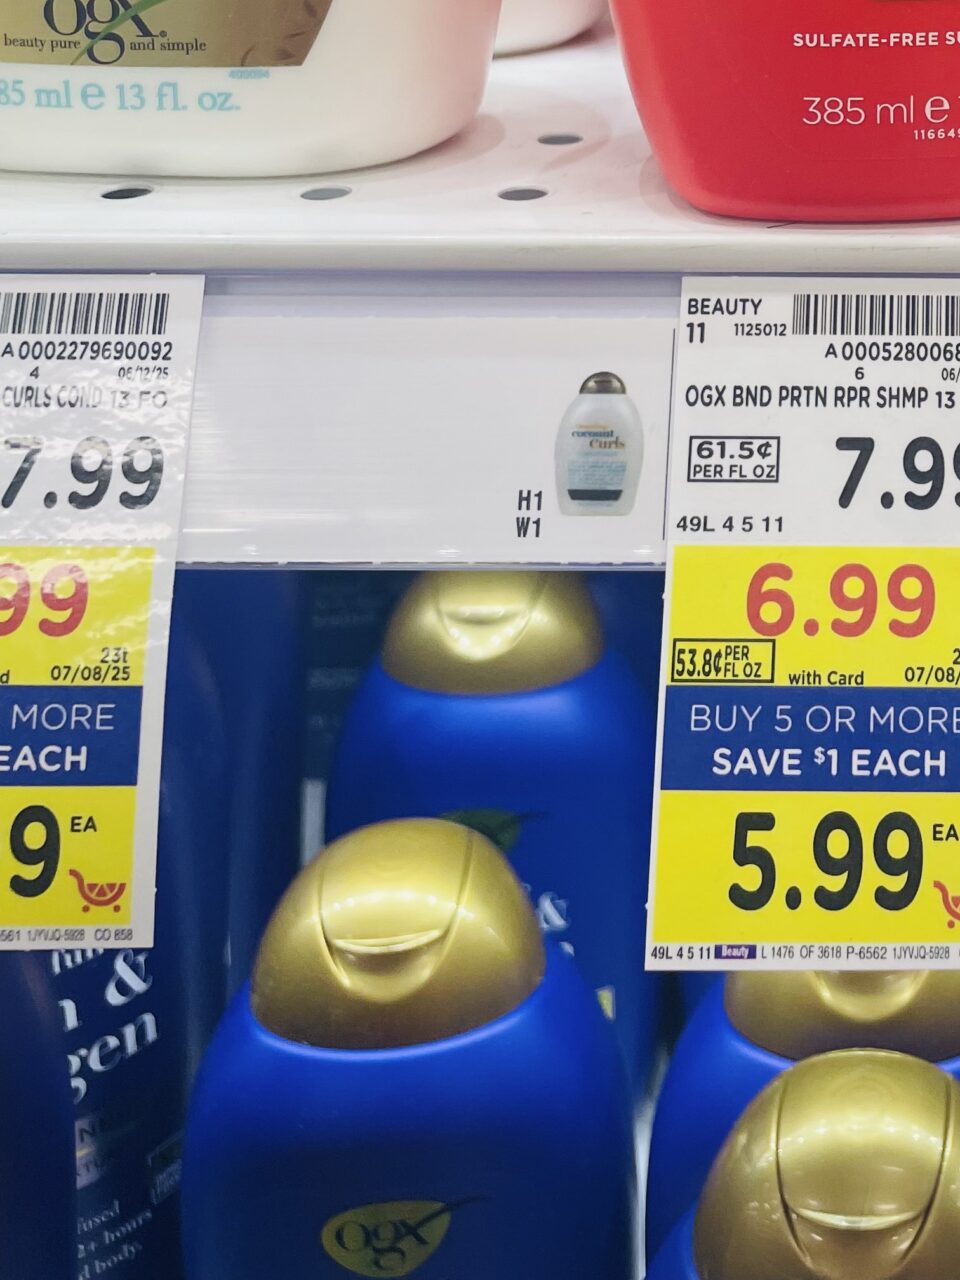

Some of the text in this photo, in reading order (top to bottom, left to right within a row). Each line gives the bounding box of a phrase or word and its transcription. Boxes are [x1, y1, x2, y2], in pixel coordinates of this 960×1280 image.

[3, 33, 207, 55] beauty pure and simple
[793, 30, 939, 49] SULFATE-FREE
[35, 79, 241, 112] ml 13 fl. oz.
[801, 95, 866, 126] 385
[876, 94, 915, 125] ml
[687, 297, 763, 316] BEAUTY
[686, 322, 787, 344] 11 1125012
[685, 384, 727, 408] OGX
[733, 385, 772, 408] BND
[778, 385, 827, 408] PRTN
[834, 386, 871, 409] RPR
[876, 387, 929, 409] SHMP
[935, 391, 956, 409] 13
[696, 440, 772, 460] 61.5¢
[0, 435, 165, 510] 7.99
[692, 464, 776, 479] PER FL OZ
[518, 489, 543, 511] H1
[515, 516, 541, 538] W1
[676, 515, 784, 533] 49L 11
[746, 562, 936, 638] 6.99
[676, 647, 723, 678] 53.8¢
[725, 645, 749, 661] PER
[50, 666, 130, 682] 07/08/25
[723, 662, 762, 678] FL OZ
[788, 670, 865, 686] with Card
[11, 703, 116, 732] MORE
[690, 704, 762, 732] BUY
[774, 705, 793, 732] 5
[805, 706, 856, 733] OR
[712, 747, 946, 777] SAVE $1 EACH
[70, 816, 97, 833] EA
[932, 823, 960, 842] EA
[9, 805, 61, 898] 9
[728, 810, 924, 911] 5.99
[721, 946, 749, 960] Beauty
[771, 946, 795, 960] 1476
[818, 946, 842, 959] 3618
[846, 946, 887, 960] P-6562
